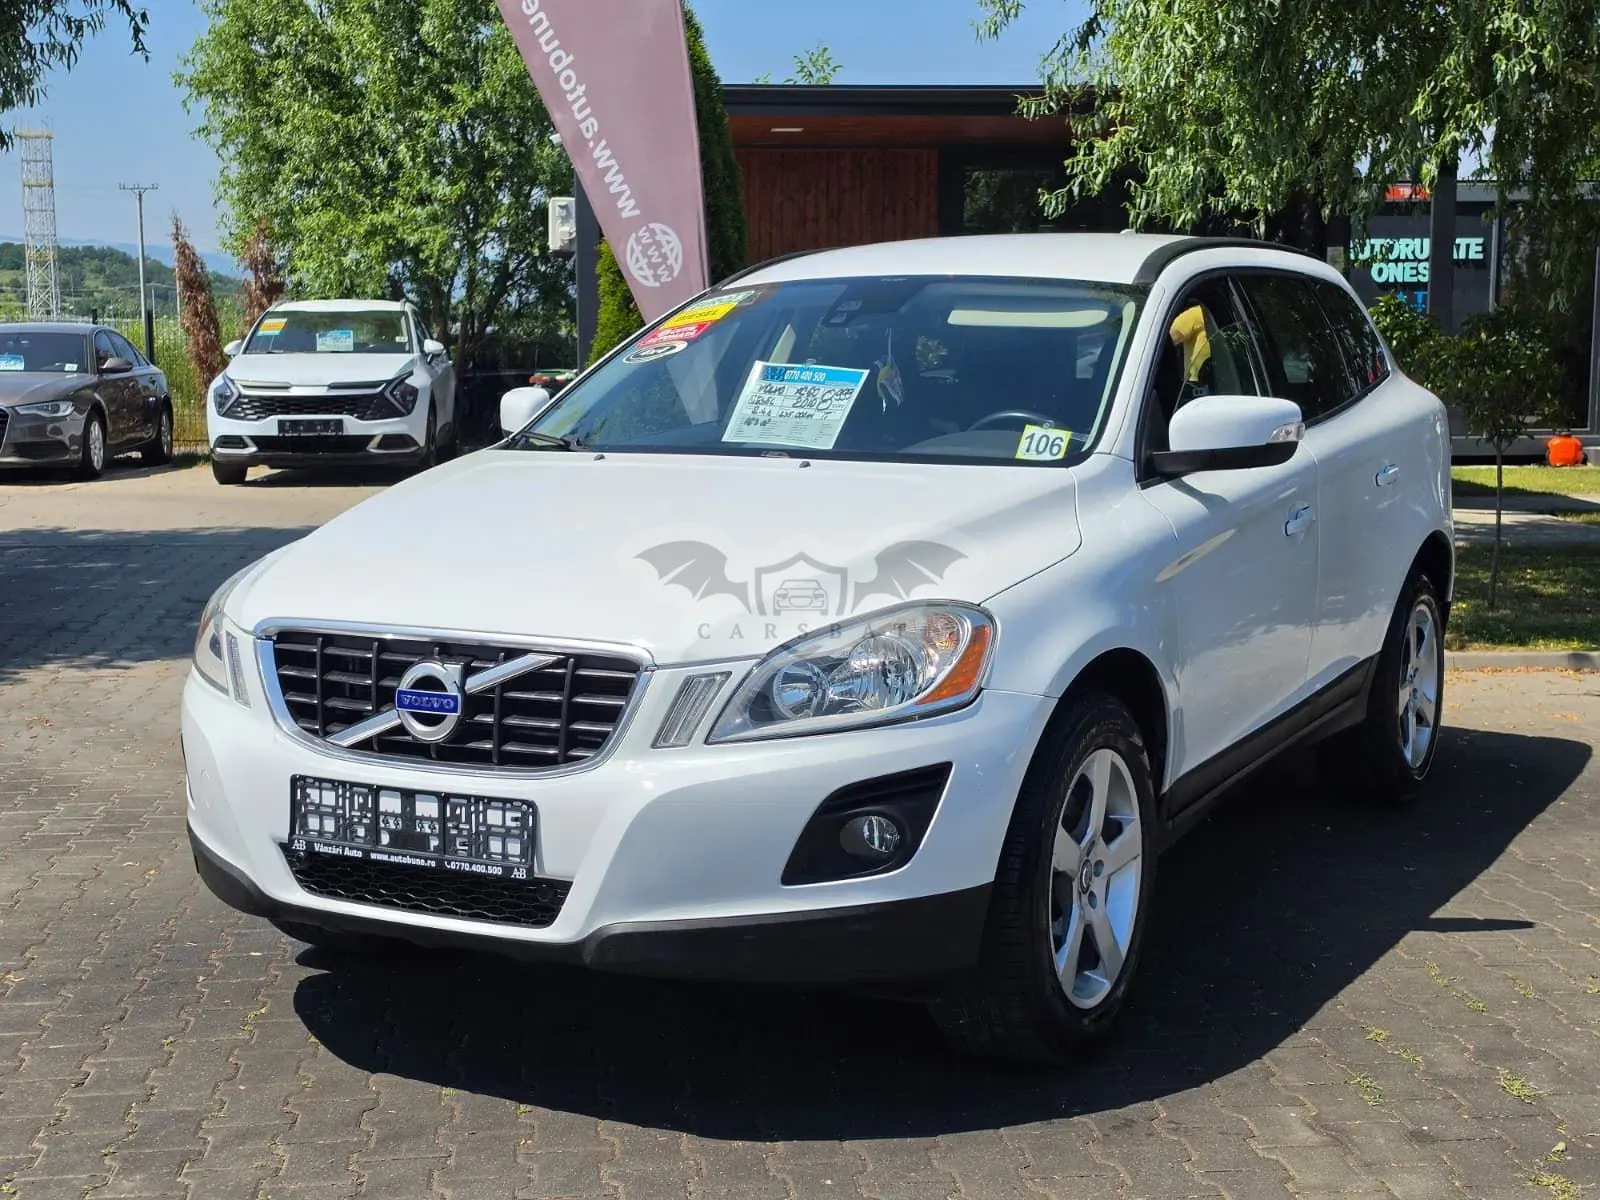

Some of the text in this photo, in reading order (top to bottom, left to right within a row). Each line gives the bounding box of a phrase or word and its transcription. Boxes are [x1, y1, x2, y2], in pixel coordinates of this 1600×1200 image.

[1025, 432, 1064, 456] 106
[401, 694, 454, 709] VOLVO
[343, 846, 362, 858] Auto
